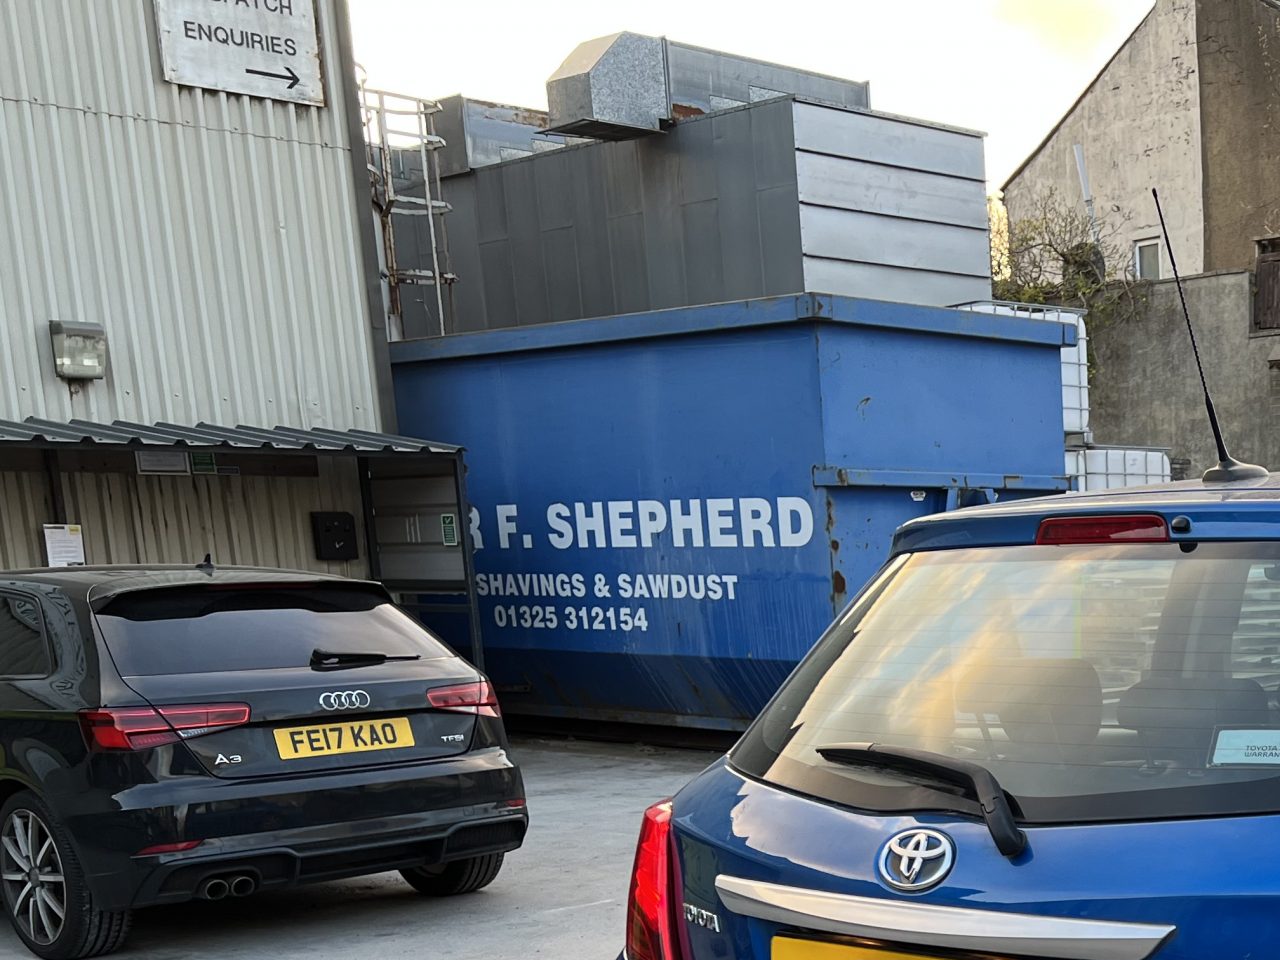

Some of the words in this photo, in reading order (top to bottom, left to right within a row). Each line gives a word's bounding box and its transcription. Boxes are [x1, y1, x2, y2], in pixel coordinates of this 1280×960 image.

[183, 20, 297, 56] ENQUIRIES
[496, 504, 533, 549] F.
[547, 497, 814, 549] SHEPHERD
[475, 573, 586, 598] SHAVINGS
[593, 573, 612, 598] &
[617, 573, 737, 599] SAWDUST
[494, 605, 558, 629] 01325
[564, 606, 648, 632] 312154
[289, 727, 343, 754] FE17
[350, 722, 398, 748] KAO
[214, 753, 242, 765] A3
